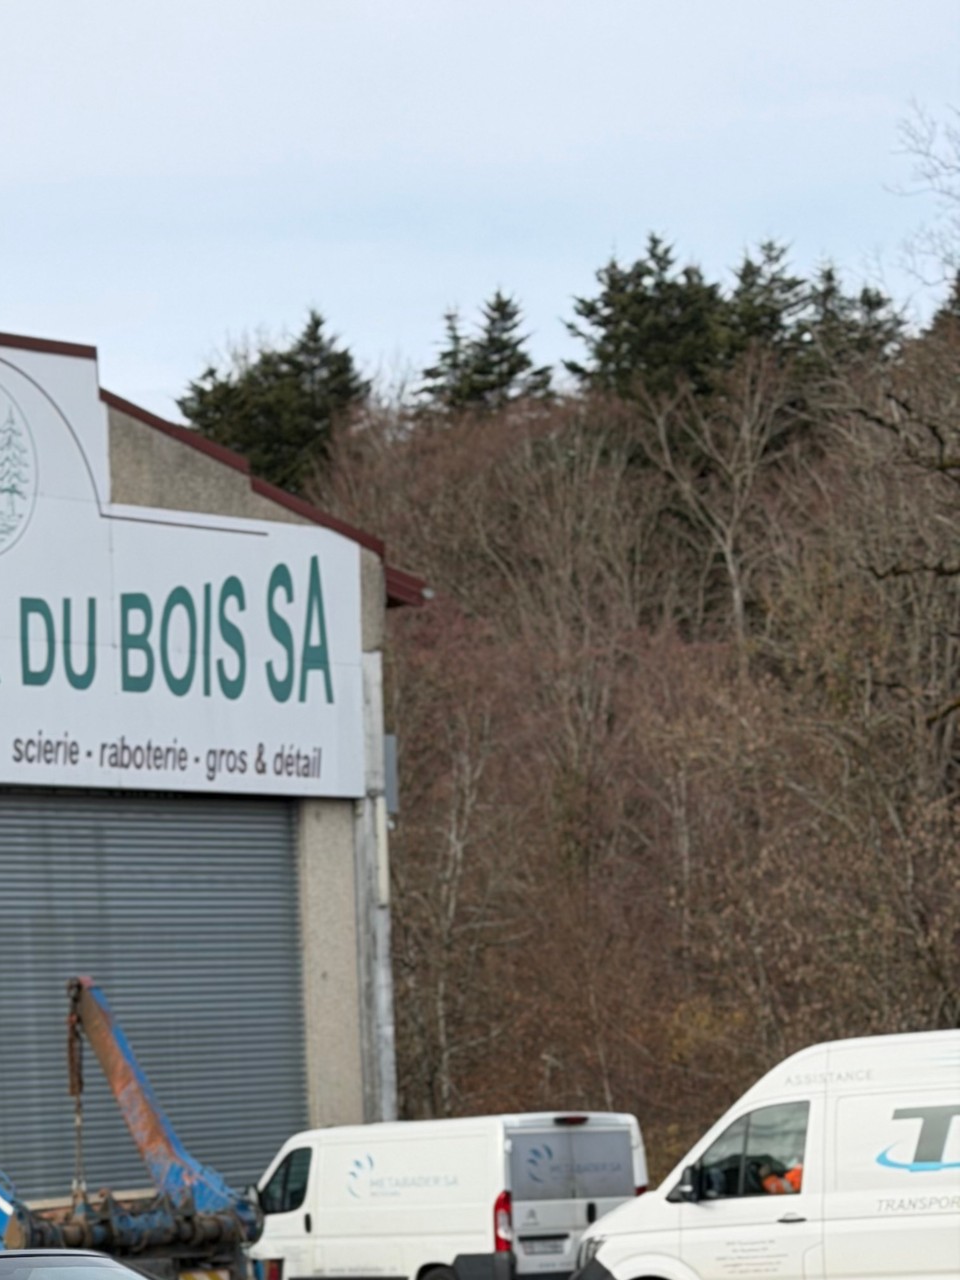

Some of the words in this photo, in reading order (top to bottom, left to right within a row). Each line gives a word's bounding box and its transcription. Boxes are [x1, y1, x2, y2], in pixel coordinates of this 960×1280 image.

[19, 596, 97, 691] DU
[119, 574, 247, 701] BOIS
[264, 554, 335, 705] SA
[12, 730, 80, 766] scierie
[99, 735, 189, 772] raboterie
[206, 748, 248, 782] gros
[254, 742, 267, 775] &
[273, 744, 322, 779] détail
[785, 1068, 874, 1087] ASSISTANCE
